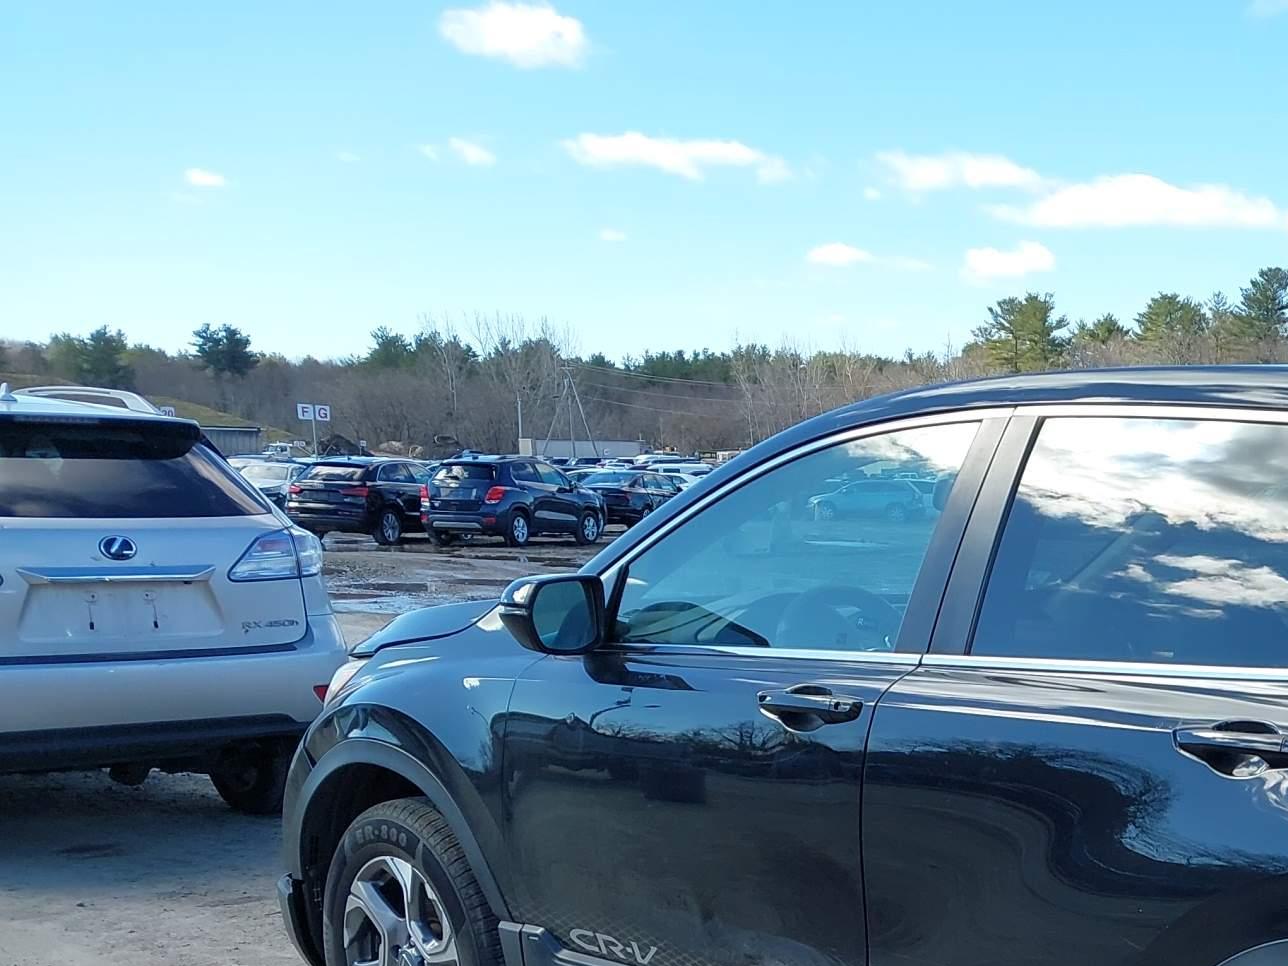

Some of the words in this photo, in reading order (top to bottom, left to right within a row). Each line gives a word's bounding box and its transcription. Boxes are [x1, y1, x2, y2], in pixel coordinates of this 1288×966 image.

[301, 406, 310, 418] F
[318, 407, 329, 419] G
[241, 620, 263, 630] RX
[569, 928, 658, 965] CR-V
